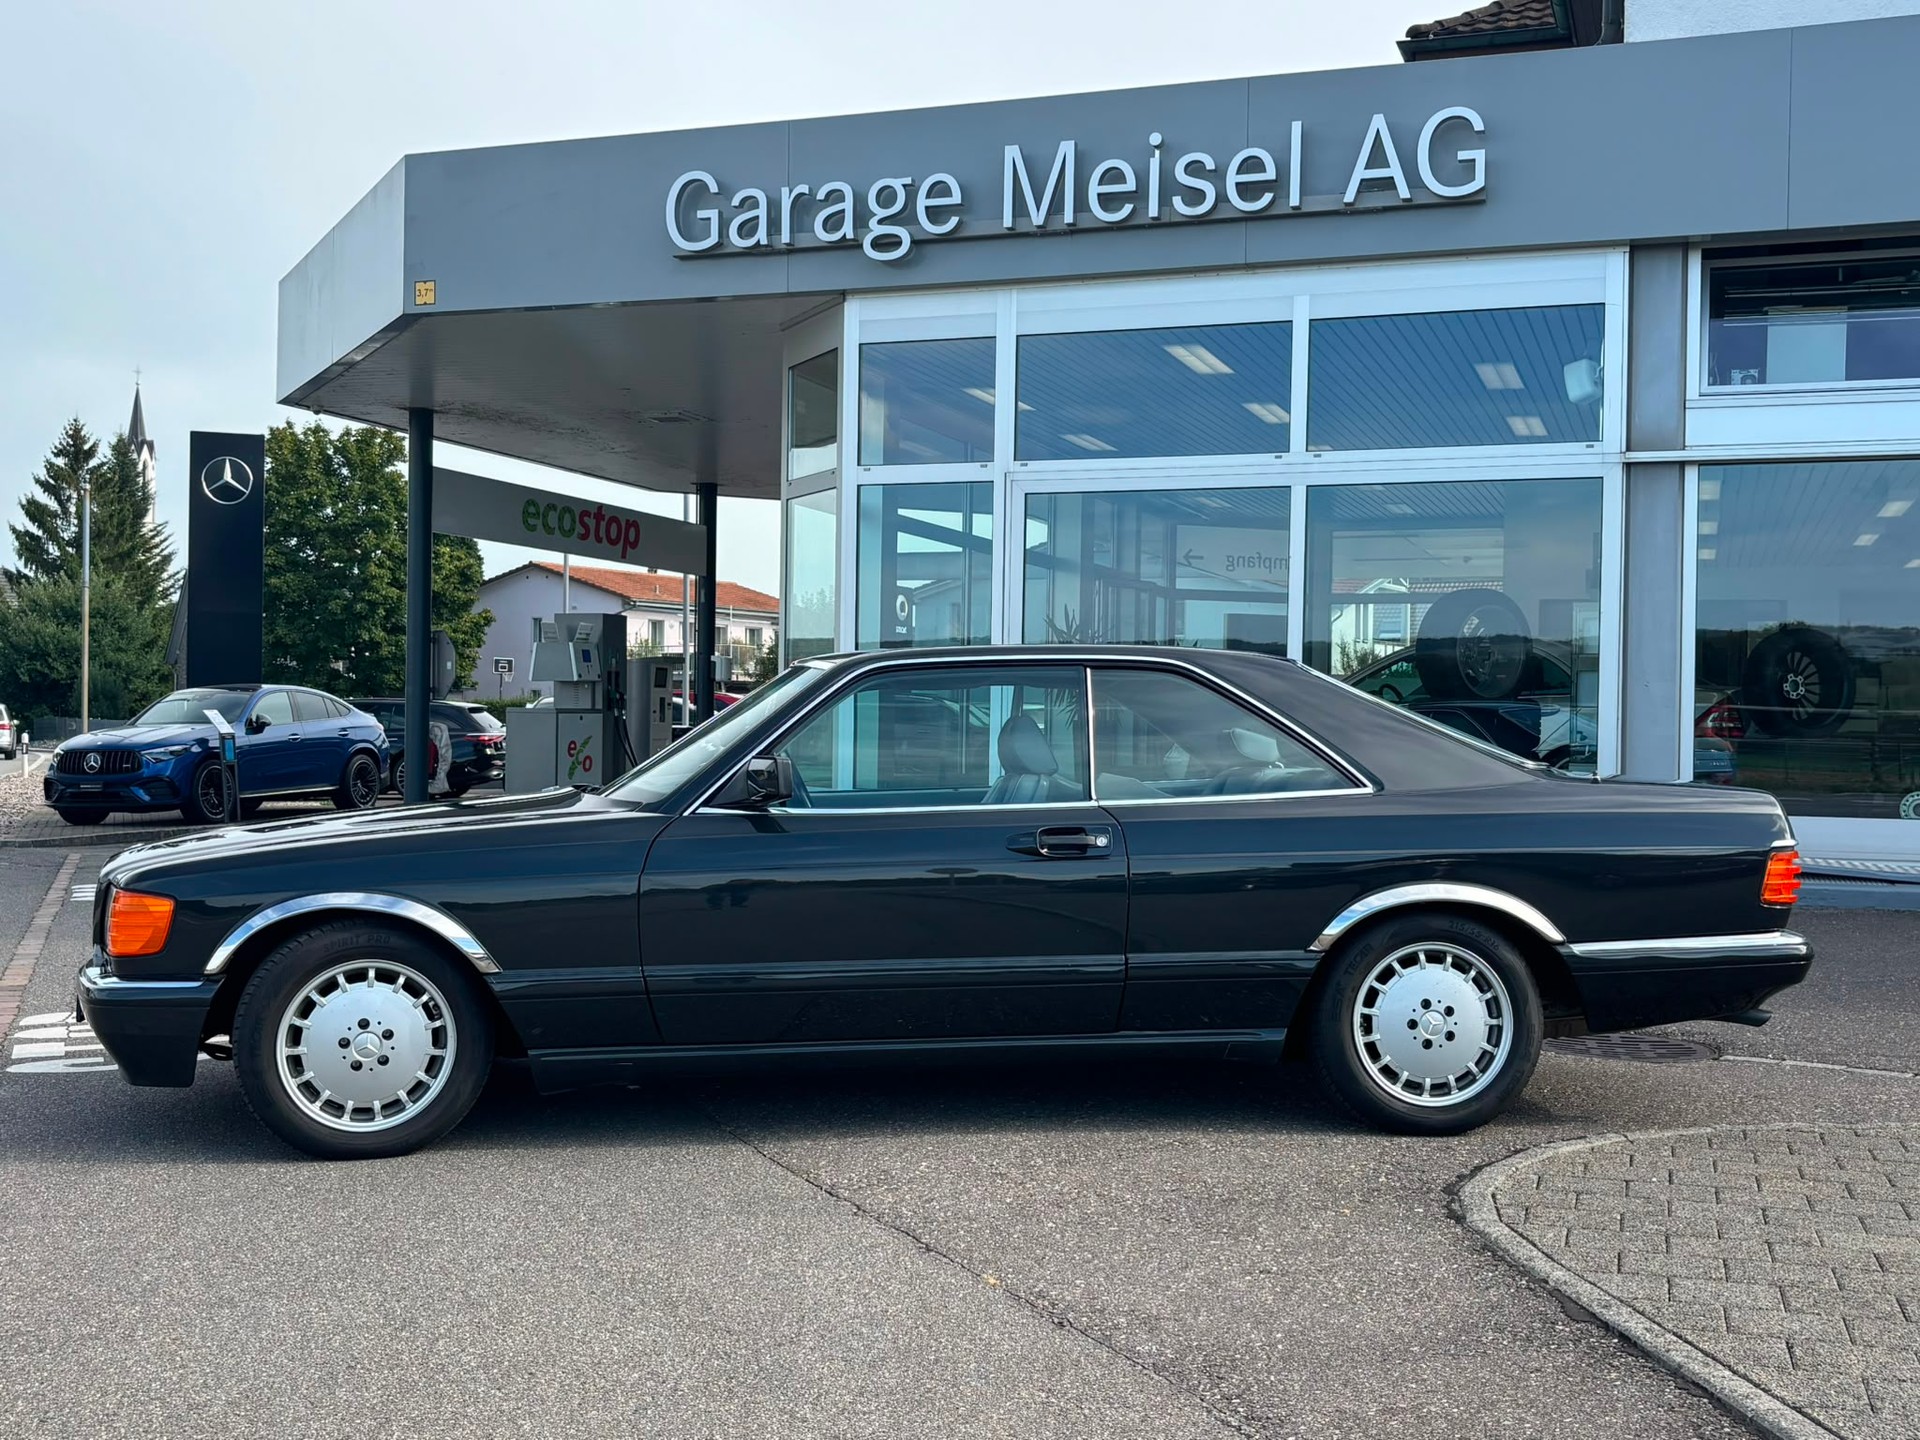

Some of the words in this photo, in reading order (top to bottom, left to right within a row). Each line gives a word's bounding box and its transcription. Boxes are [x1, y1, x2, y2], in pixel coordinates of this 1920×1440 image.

[665, 170, 962, 261] Garage
[1003, 121, 1302, 229] Meisel
[1343, 106, 1486, 203] AG
[522, 499, 640, 559] ecostop
[323, 936, 361, 953] SPIRIT
[367, 935, 391, 945] PRO
